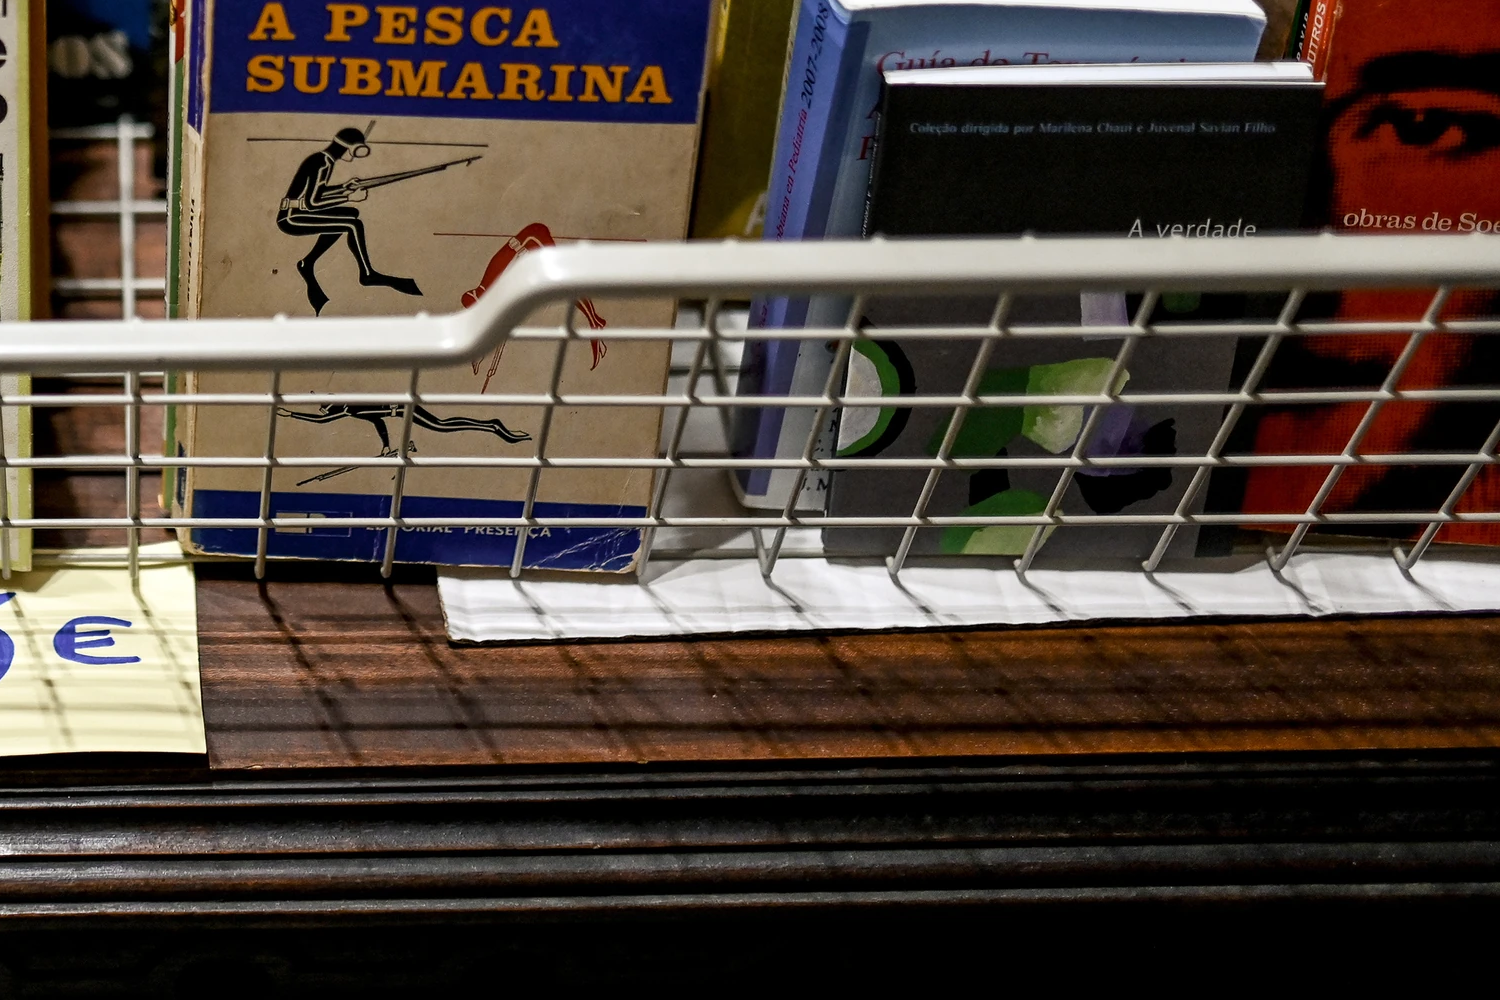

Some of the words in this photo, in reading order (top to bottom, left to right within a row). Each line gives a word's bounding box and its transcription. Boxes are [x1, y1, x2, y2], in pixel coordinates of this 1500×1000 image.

[248, 2, 296, 41] A
[324, 3, 561, 49] PESCA
[1306, 1, 1327, 66] UTROS
[245, 54, 673, 104] SUBMARINA
[800, 2, 829, 110] 2007-2008
[1128, 218, 1145, 238] A
[1155, 217, 1257, 239] verdade
[1343, 208, 1416, 230] obras
[1422, 211, 1452, 231] de
[1456, 212, 1500, 233] Soe
[53, 615, 141, 665] €
